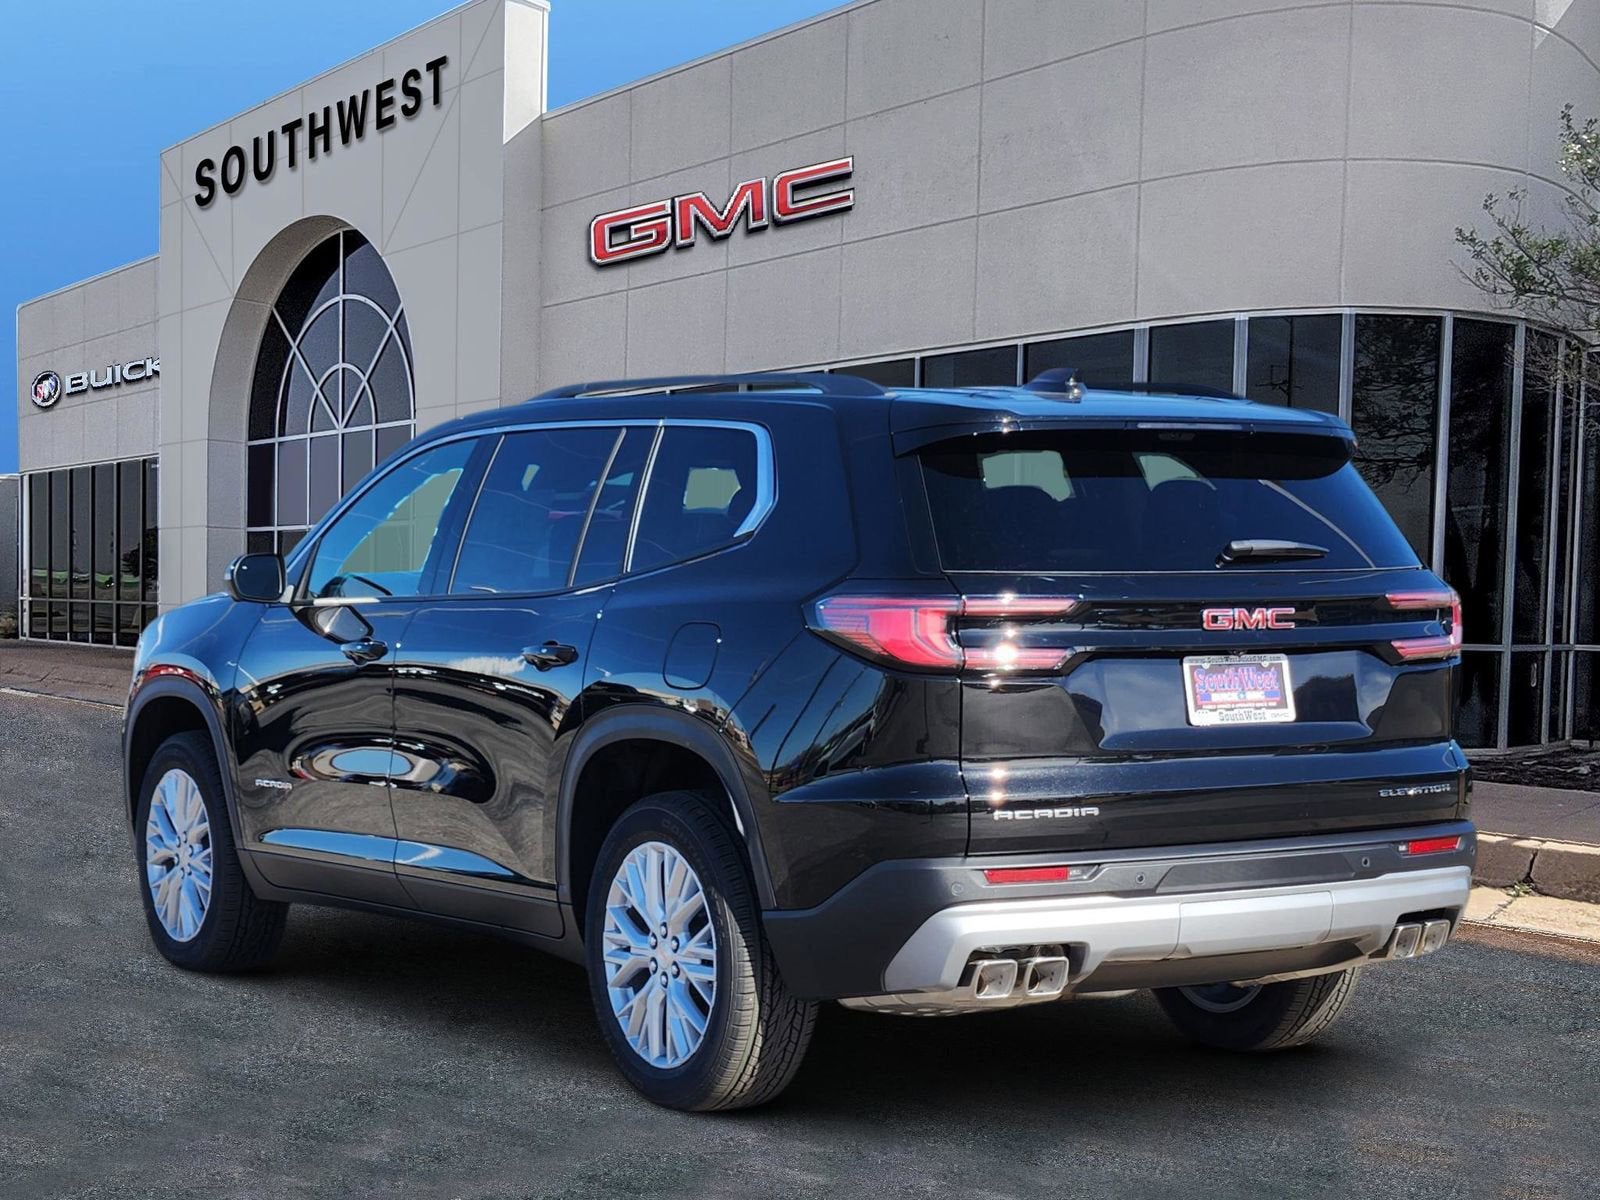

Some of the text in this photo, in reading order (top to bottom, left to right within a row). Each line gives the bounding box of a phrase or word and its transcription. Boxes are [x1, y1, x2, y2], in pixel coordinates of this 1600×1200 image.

[194, 55, 448, 207] SOUTHWEST
[589, 155, 855, 266] GMC
[1203, 607, 1295, 630] GMC
[1194, 667, 1280, 693] SouthWest
[1218, 711, 1267, 722] SouthWest
[1379, 783, 1451, 798] ELEVATION
[993, 807, 1100, 820] ACADIA
